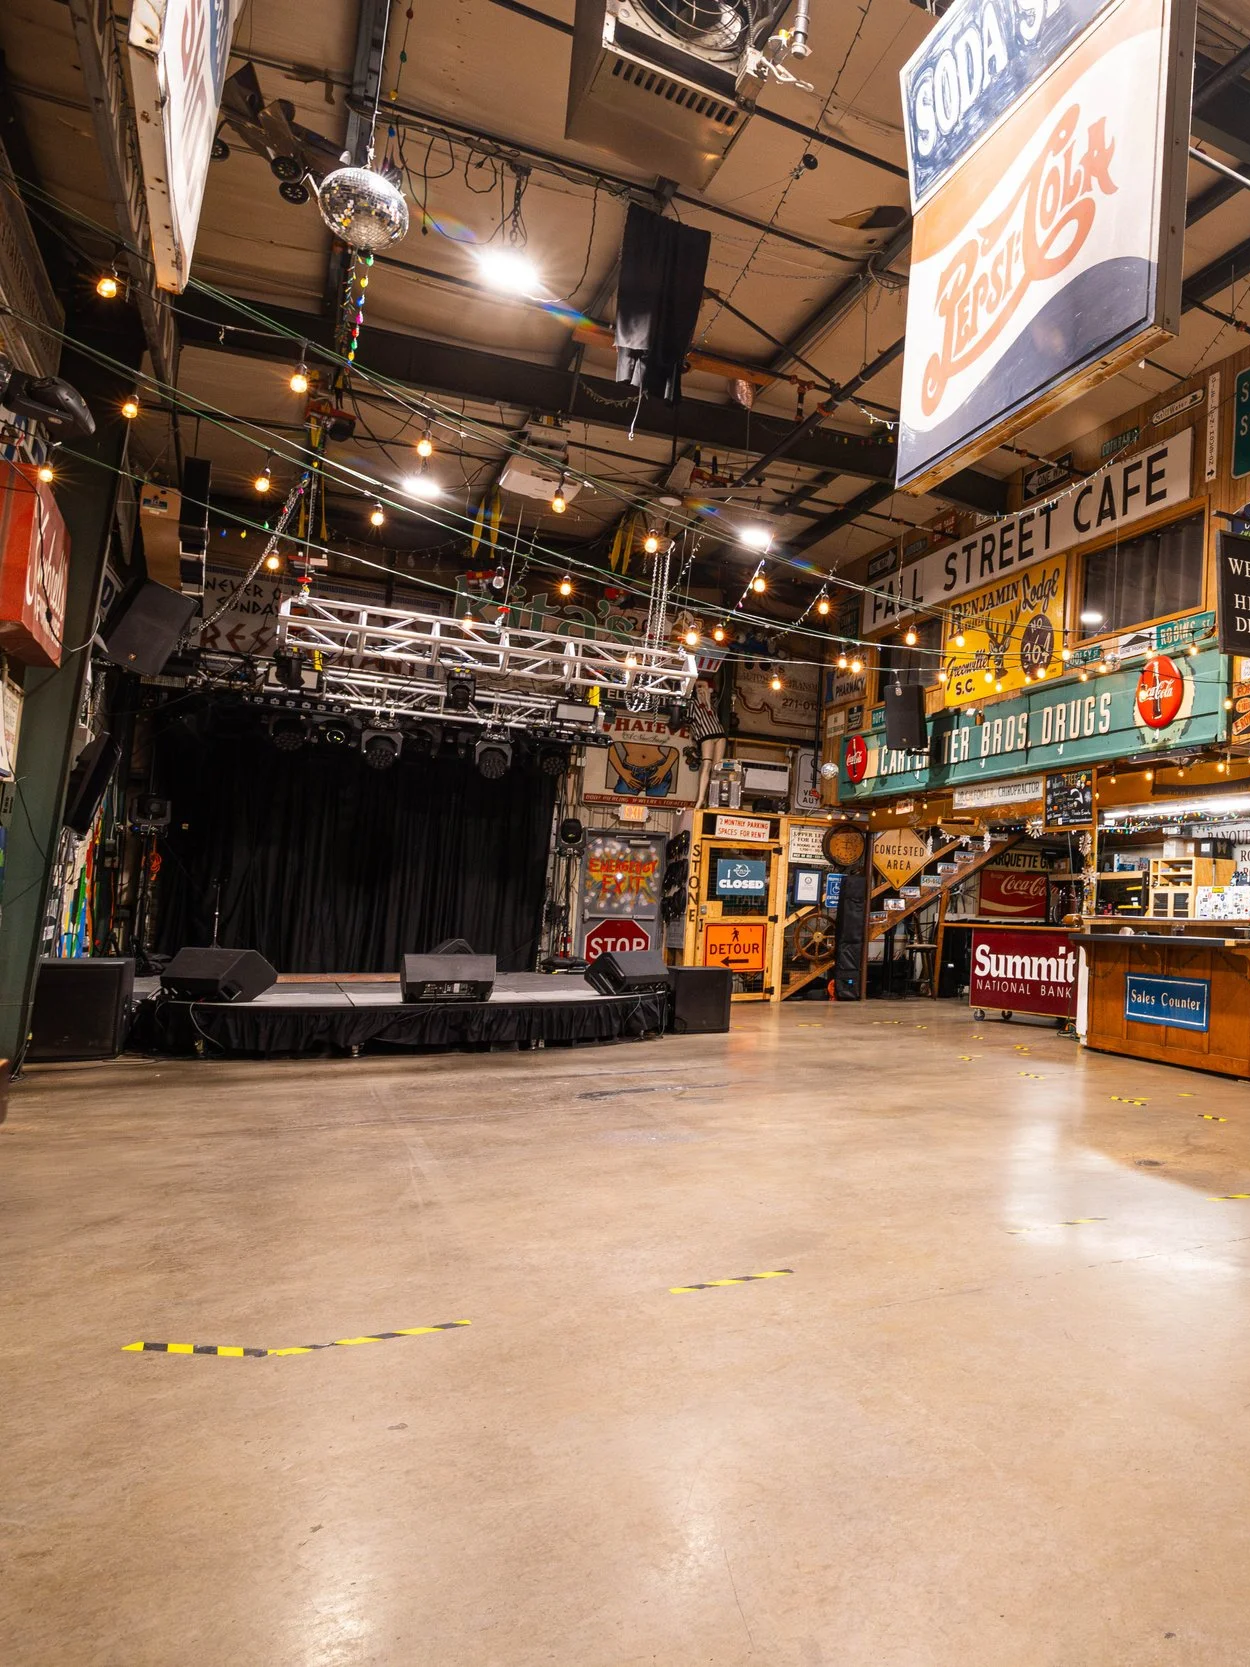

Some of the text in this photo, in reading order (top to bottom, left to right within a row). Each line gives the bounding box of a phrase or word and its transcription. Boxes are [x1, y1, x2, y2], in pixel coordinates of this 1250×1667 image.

[915, 4, 1008, 156] SODA
[872, 447, 1169, 625] FALL STREET CAFE
[948, 567, 1060, 617] BENJAMIN Lodge
[835, 676, 865, 697] PHARMACY
[955, 678, 976, 696] S.C.
[981, 712, 1031, 756] BROS.
[1042, 692, 1111, 745] DRUGS
[998, 781, 1040, 797] CHIROPRACTOR
[624, 806, 644, 819] EXIT
[718, 828, 765, 838] SPACES FOR RENT
[724, 819, 746, 828] MONTHLY
[747, 821, 769, 829] PARKING
[874, 844, 925, 857] CONGESTED
[588, 858, 658, 874] EMERGENCY
[886, 860, 911, 870] AREA
[602, 874, 645, 896] EXIT
[719, 879, 764, 889] CLOSED
[588, 938, 646, 960] STOP
[709, 943, 760, 955] DETOUR
[974, 944, 1076, 983] Summit
[976, 979, 1073, 998] NATIONAL BANK
[1131, 988, 1201, 1011] Sales Counter
